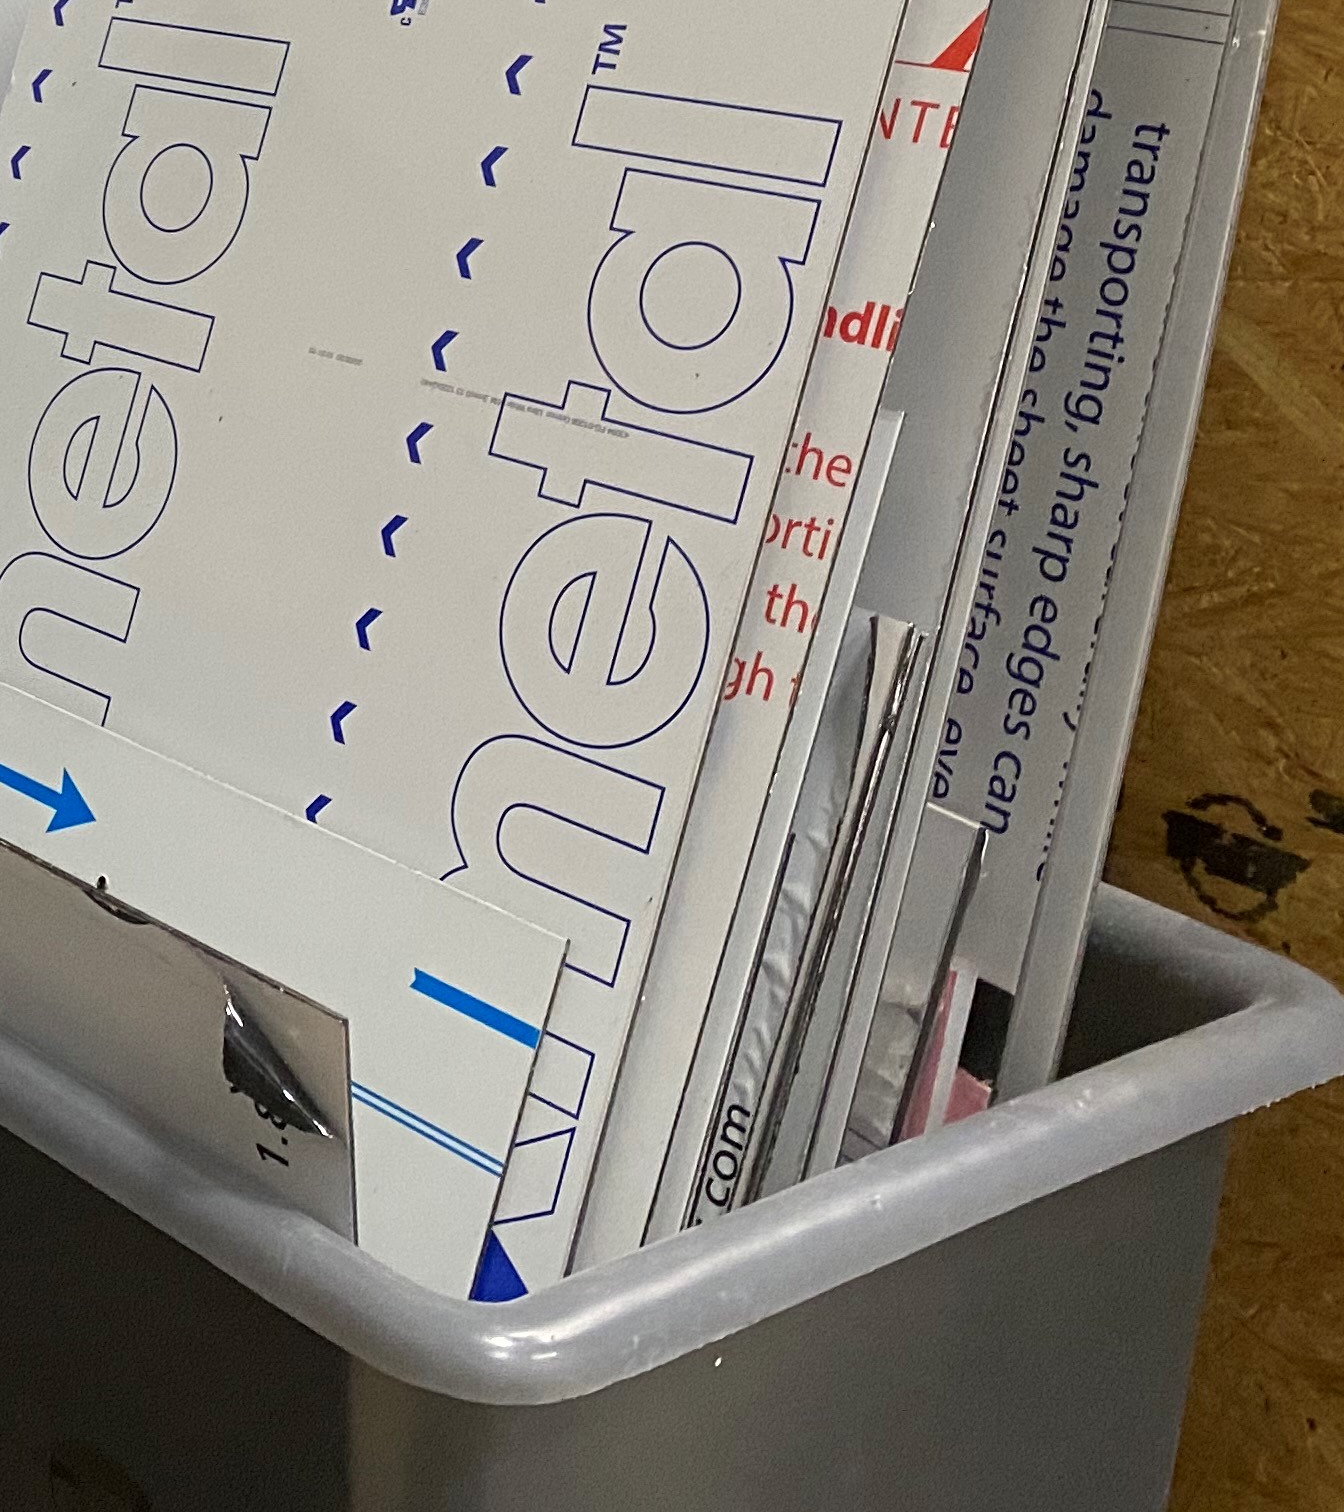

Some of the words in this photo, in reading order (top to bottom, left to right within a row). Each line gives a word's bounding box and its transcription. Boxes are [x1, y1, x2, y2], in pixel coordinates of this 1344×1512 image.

[1063, 121, 1172, 433] transporting,
[1031, 446, 1100, 583] sharp
[1005, 593, 1062, 741] edges
[978, 749, 1023, 836] can
